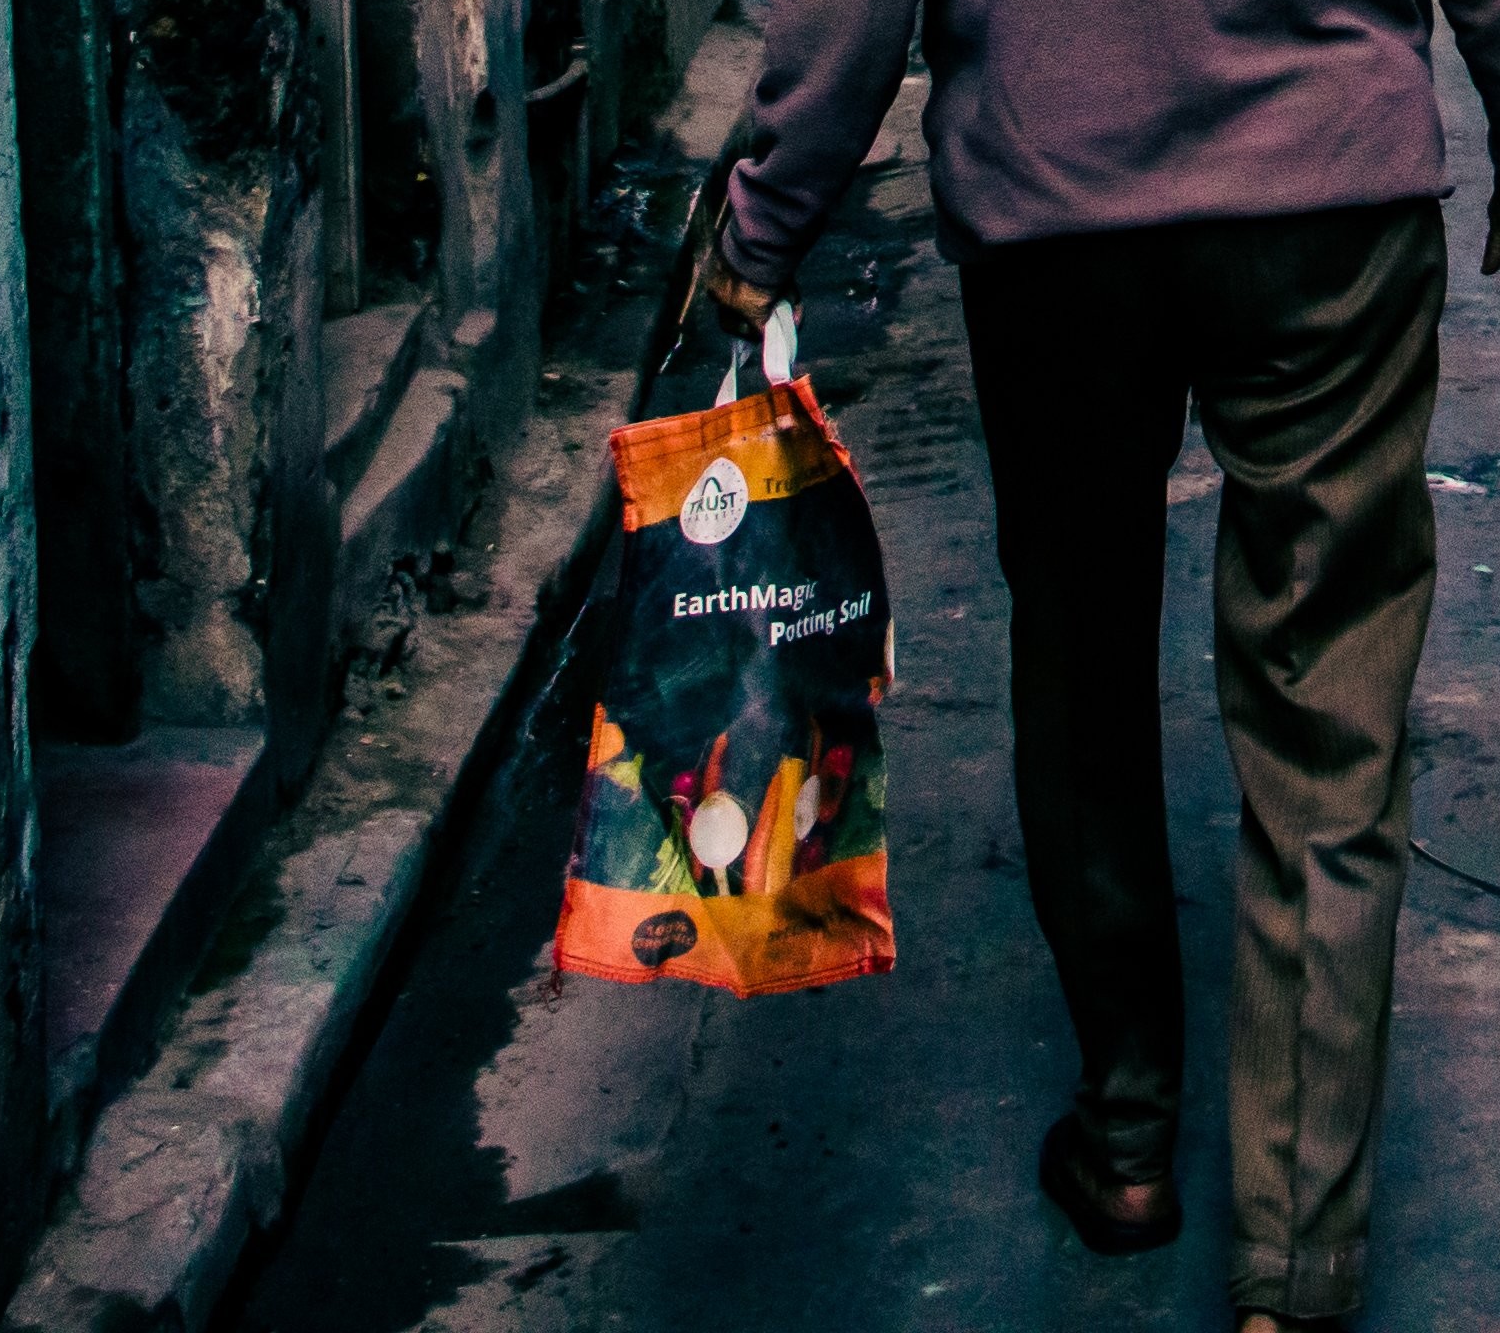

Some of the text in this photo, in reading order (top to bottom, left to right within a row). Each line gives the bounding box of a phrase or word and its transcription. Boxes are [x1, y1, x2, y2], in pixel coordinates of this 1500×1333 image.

[689, 492, 738, 515] TRUST
[673, 579, 818, 617] EarthMagic
[770, 590, 872, 647] Potting Soil
